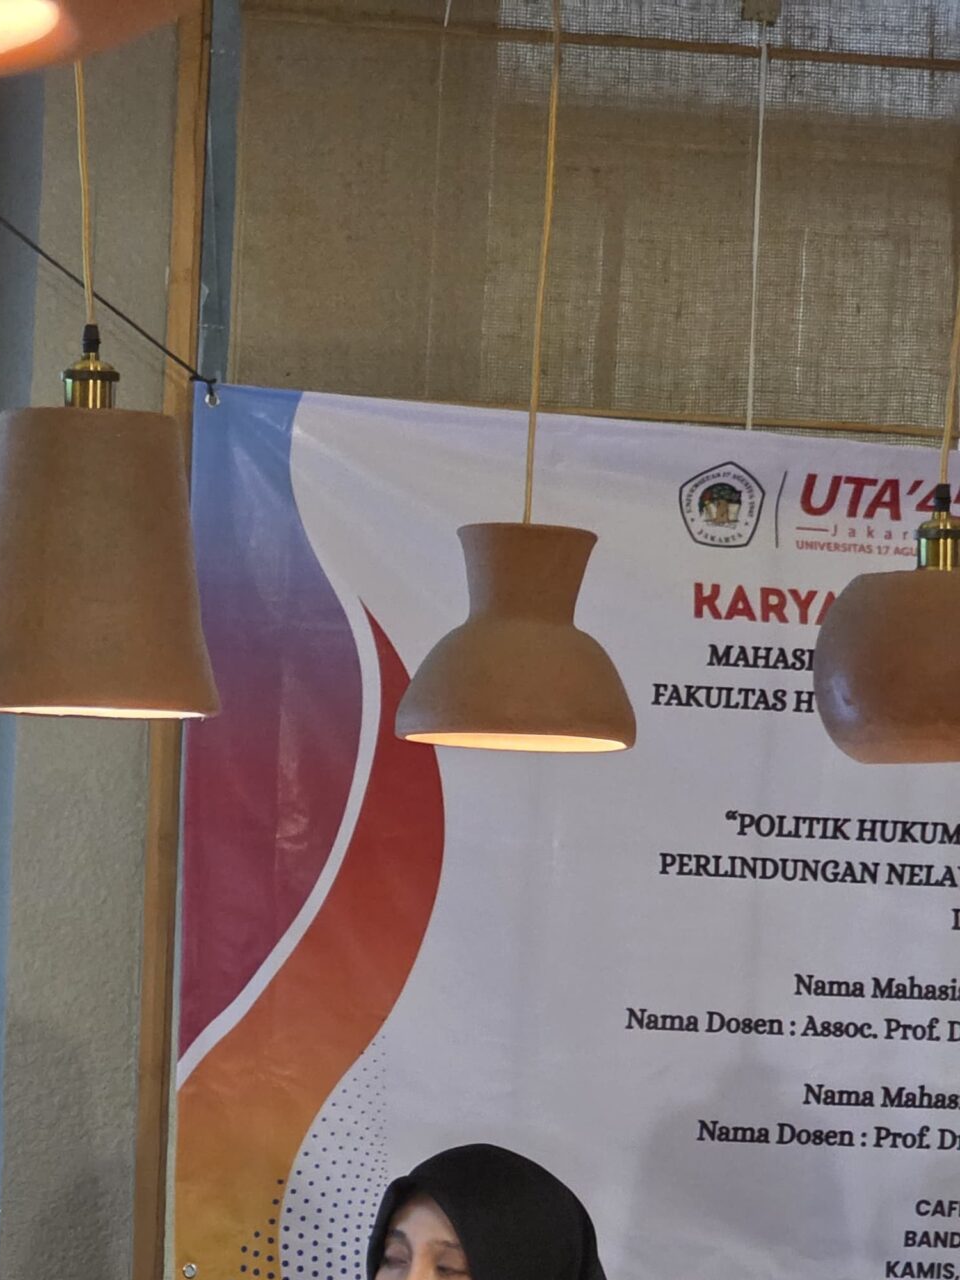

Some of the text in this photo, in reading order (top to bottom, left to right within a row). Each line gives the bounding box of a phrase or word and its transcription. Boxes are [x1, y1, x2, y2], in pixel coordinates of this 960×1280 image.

[831, 524, 910, 541] Jakar
[796, 540, 873, 554] UNIVERSITAS
[877, 545, 889, 555] 17
[651, 683, 787, 712] FAKULTAS
[659, 853, 960, 887] PERLINDUNGAN NELA
[794, 974, 865, 998] Nama
[625, 1008, 699, 1032] Nama
[705, 1011, 784, 1036] Dosen
[801, 1016, 878, 1039] Assoc.
[884, 1018, 941, 1041] Prof.
[803, 1084, 874, 1107] Nama
[696, 1120, 770, 1144] Nama
[776, 1122, 854, 1146] Dosen
[873, 1126, 931, 1149] Prof.
[915, 1199, 960, 1217] CAF
